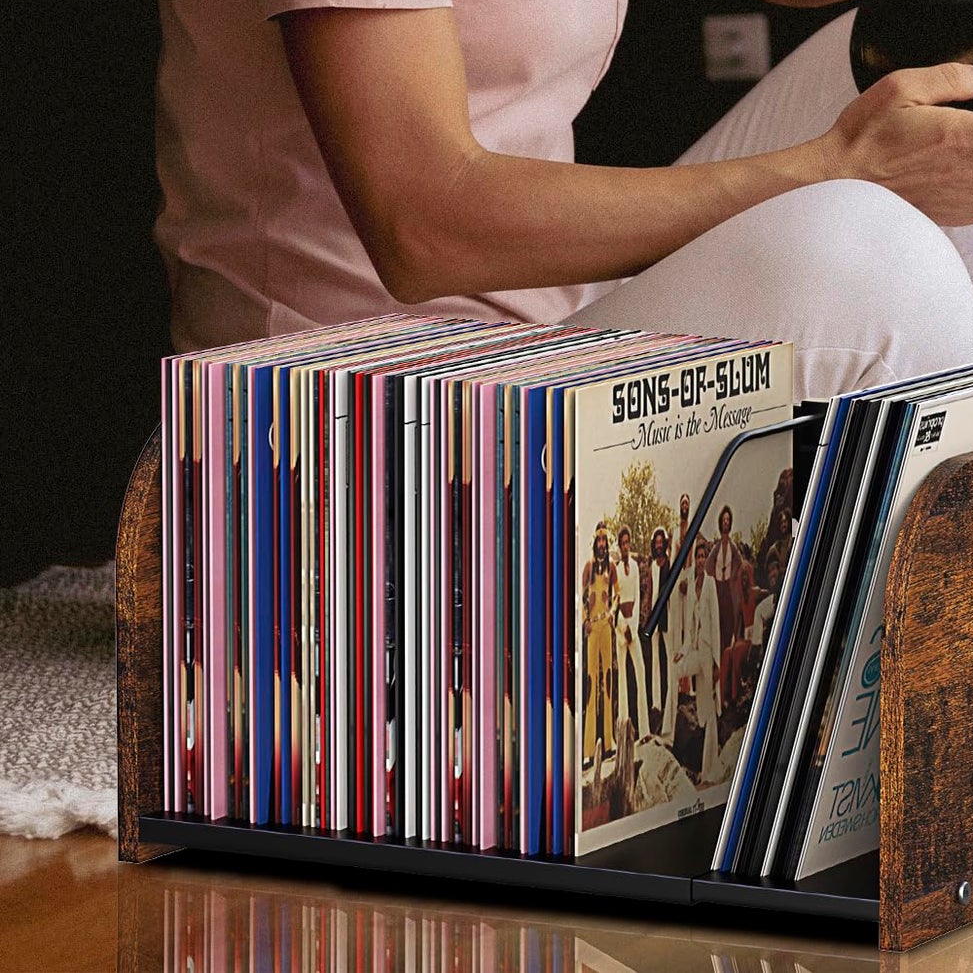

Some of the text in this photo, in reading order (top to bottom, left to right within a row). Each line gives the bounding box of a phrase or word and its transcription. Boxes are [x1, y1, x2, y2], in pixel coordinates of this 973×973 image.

[612, 352, 770, 424] SONS-OF-SLUM
[632, 404, 752, 450] Music is the Message
